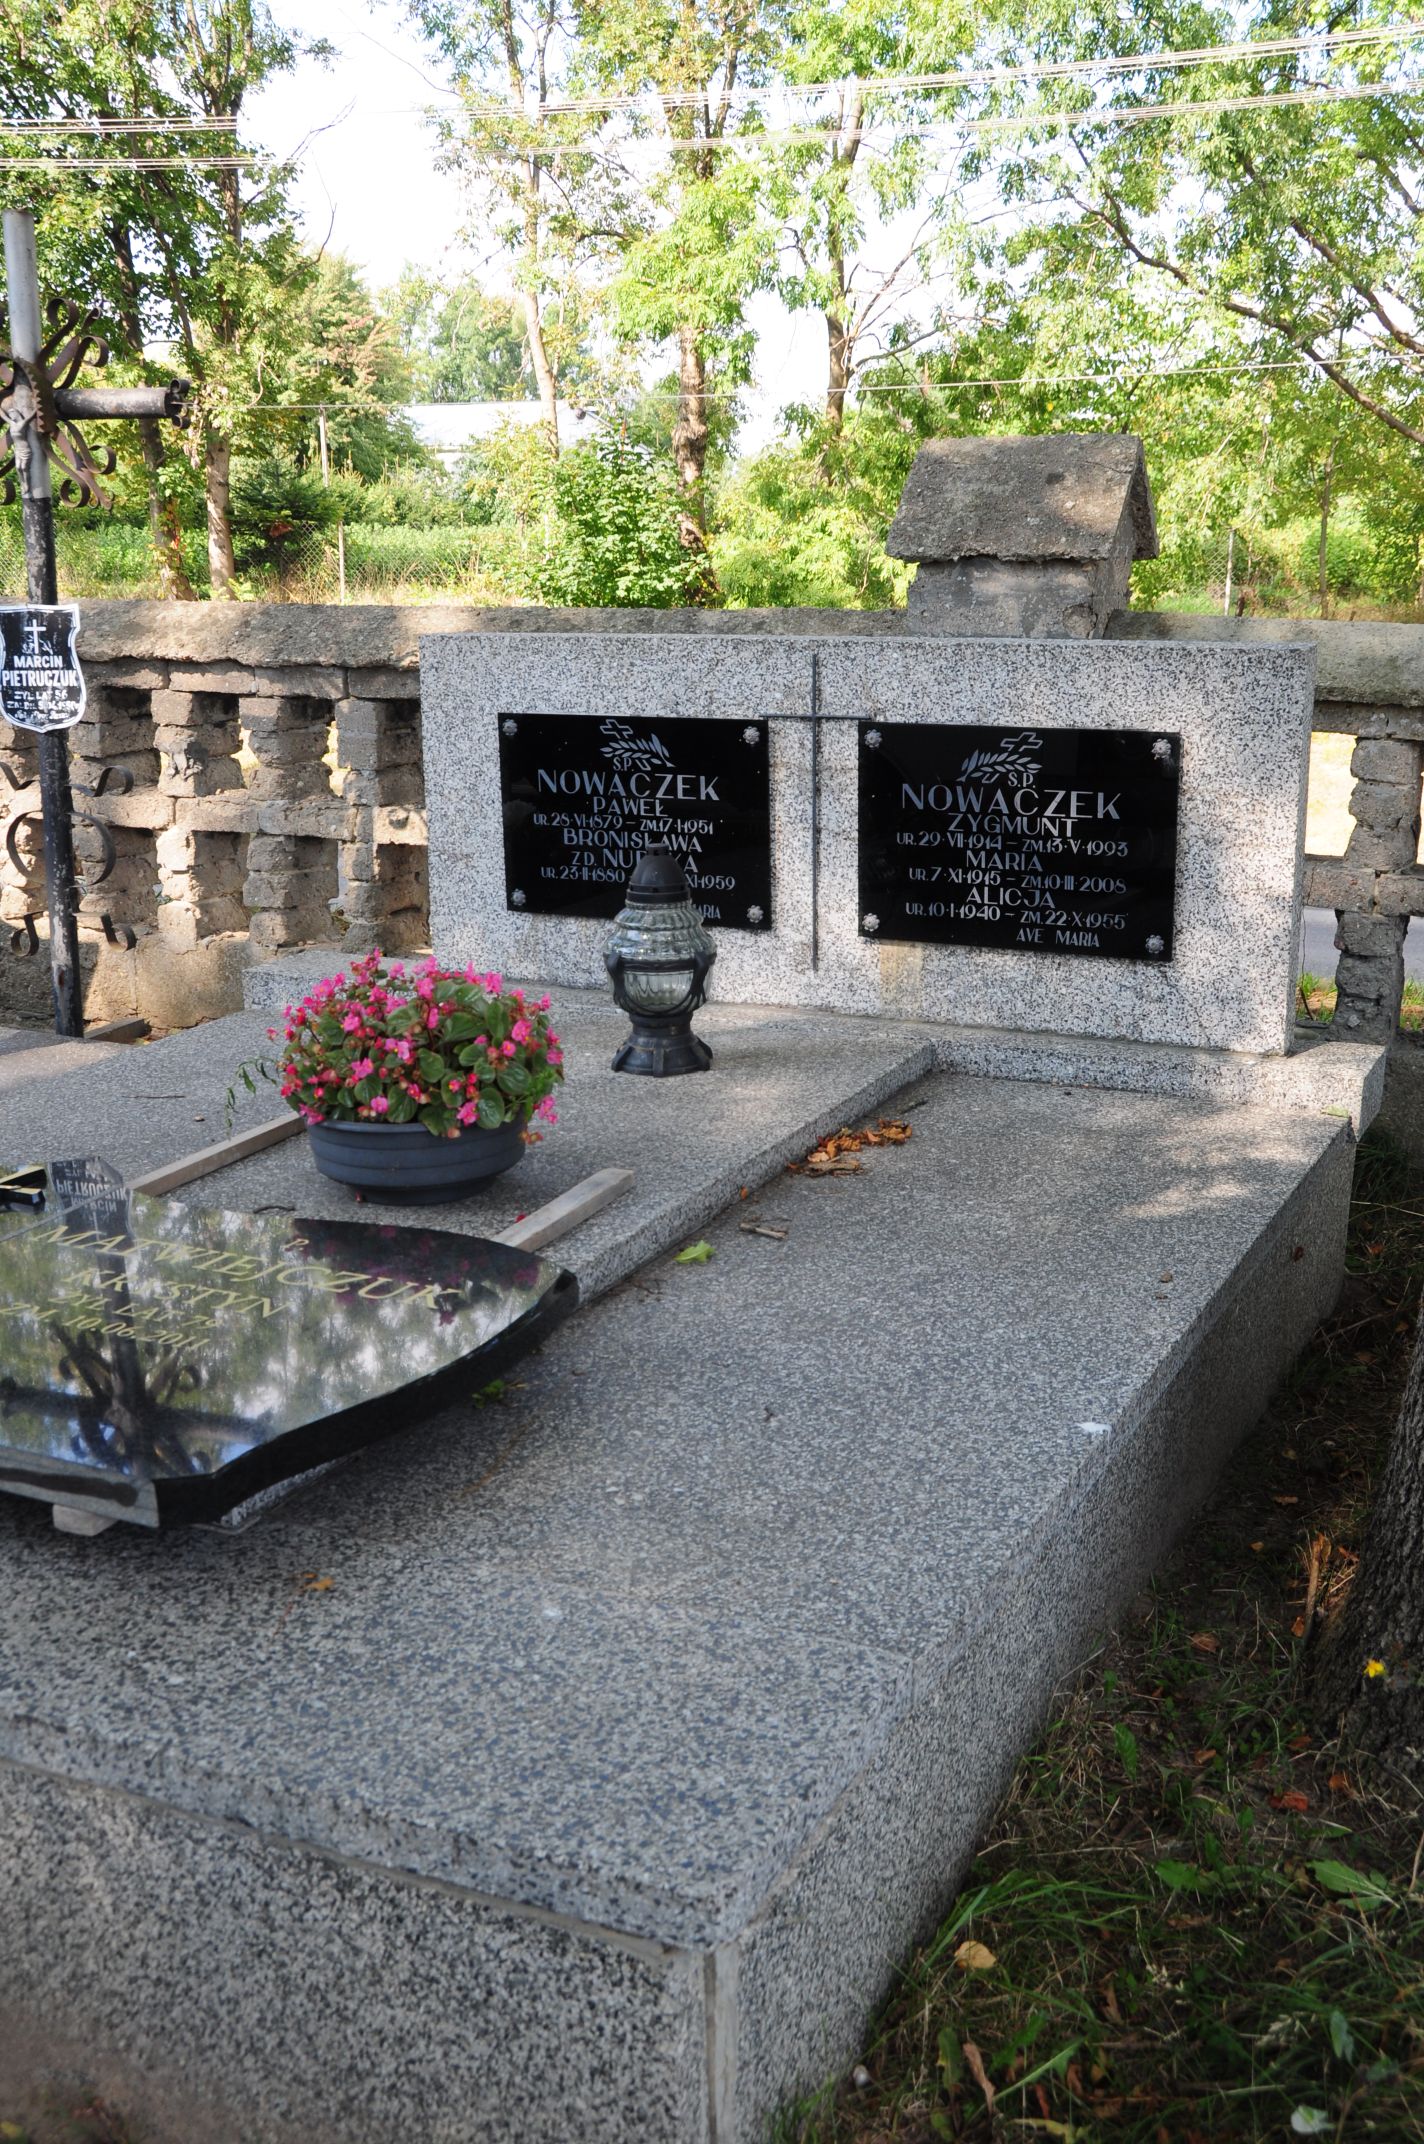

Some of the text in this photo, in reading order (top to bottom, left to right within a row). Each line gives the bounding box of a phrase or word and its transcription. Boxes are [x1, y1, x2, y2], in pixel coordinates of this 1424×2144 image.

[13, 655, 63, 668] MARCIN
[2, 669, 78, 687] PIETRUCZUK
[537, 769, 720, 801] NOWACZEK
[593, 797, 668, 817] PAWEŁ
[902, 783, 1121, 820] NOWACZEK
[947, 812, 1079, 838] ZYGMUNT
[966, 850, 1043, 872] MARIA
[966, 886, 1056, 909] ALICJA
[693, 904, 721, 919] ARIA
[1016, 928, 1100, 947] AVE MARIA
[30, 1225, 462, 1310] MATWIEJCZUK
